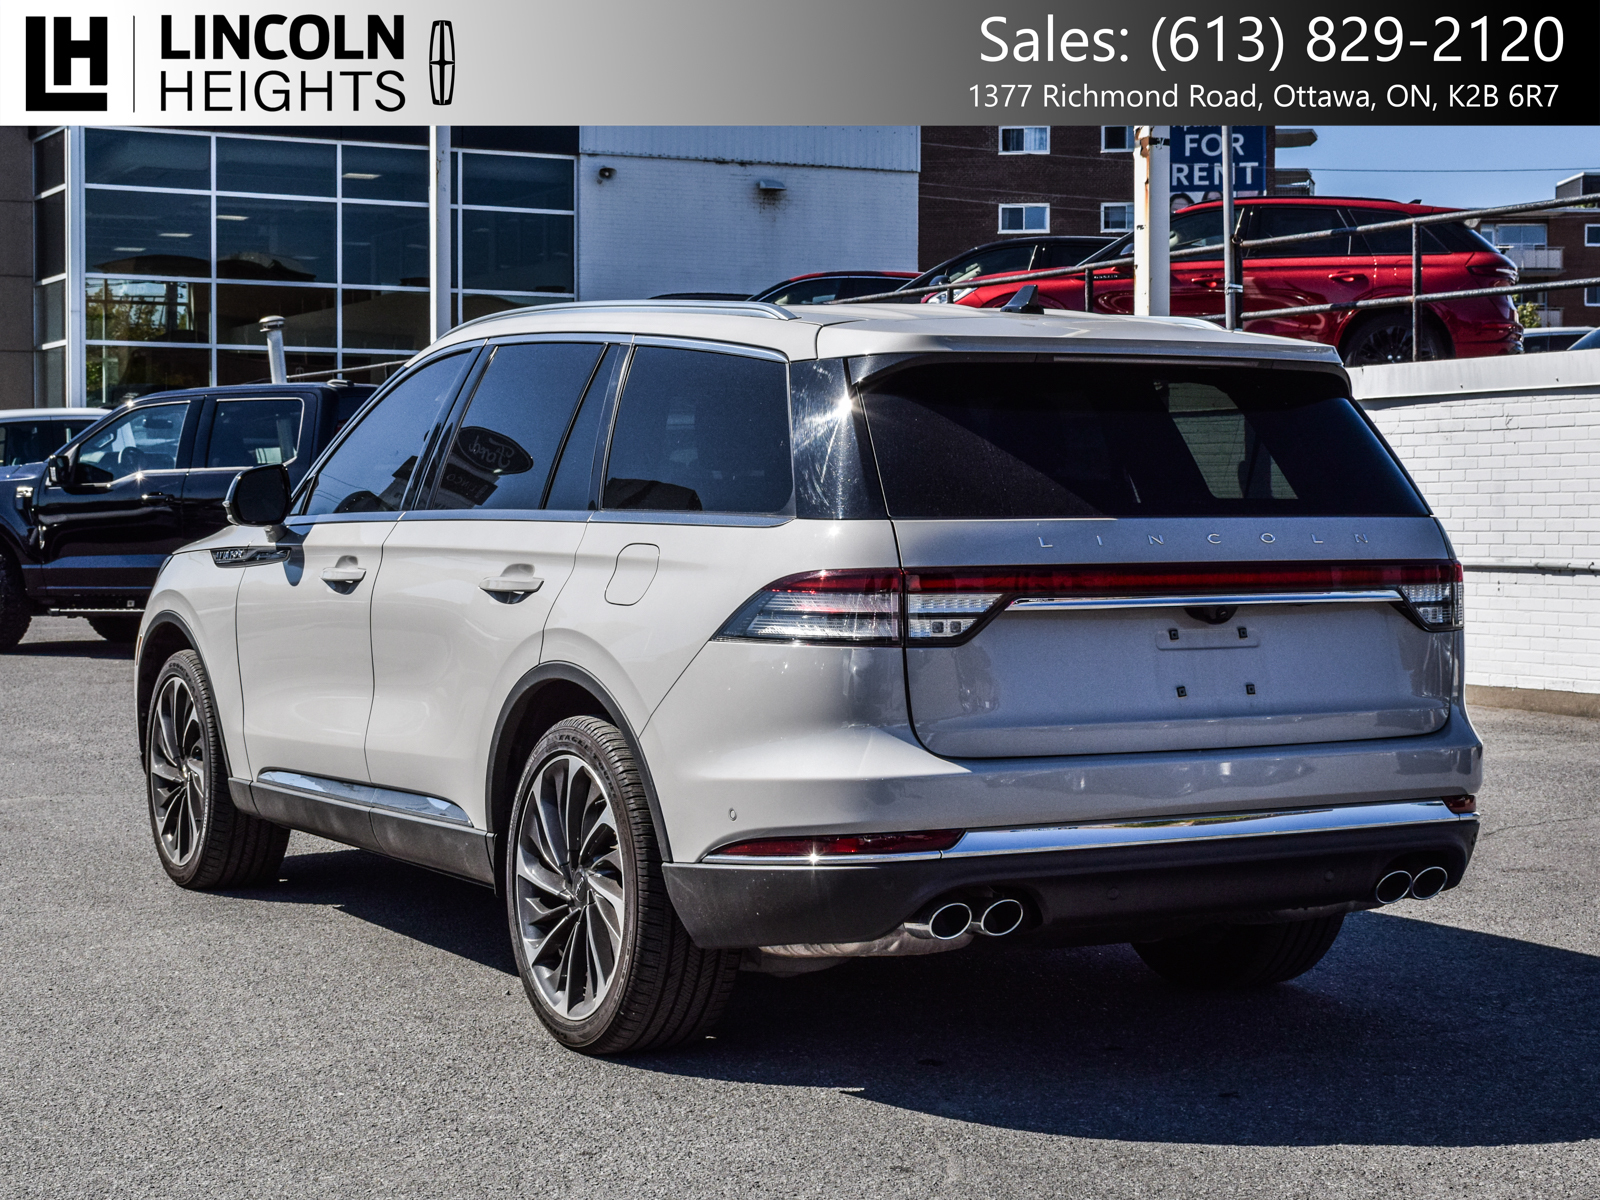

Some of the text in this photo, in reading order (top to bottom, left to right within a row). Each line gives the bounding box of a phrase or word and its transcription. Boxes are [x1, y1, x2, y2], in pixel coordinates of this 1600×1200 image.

[1184, 133, 1245, 157] FOR
[1171, 162, 1259, 186] RENT
[1037, 532, 1370, 548] LINCOLN
